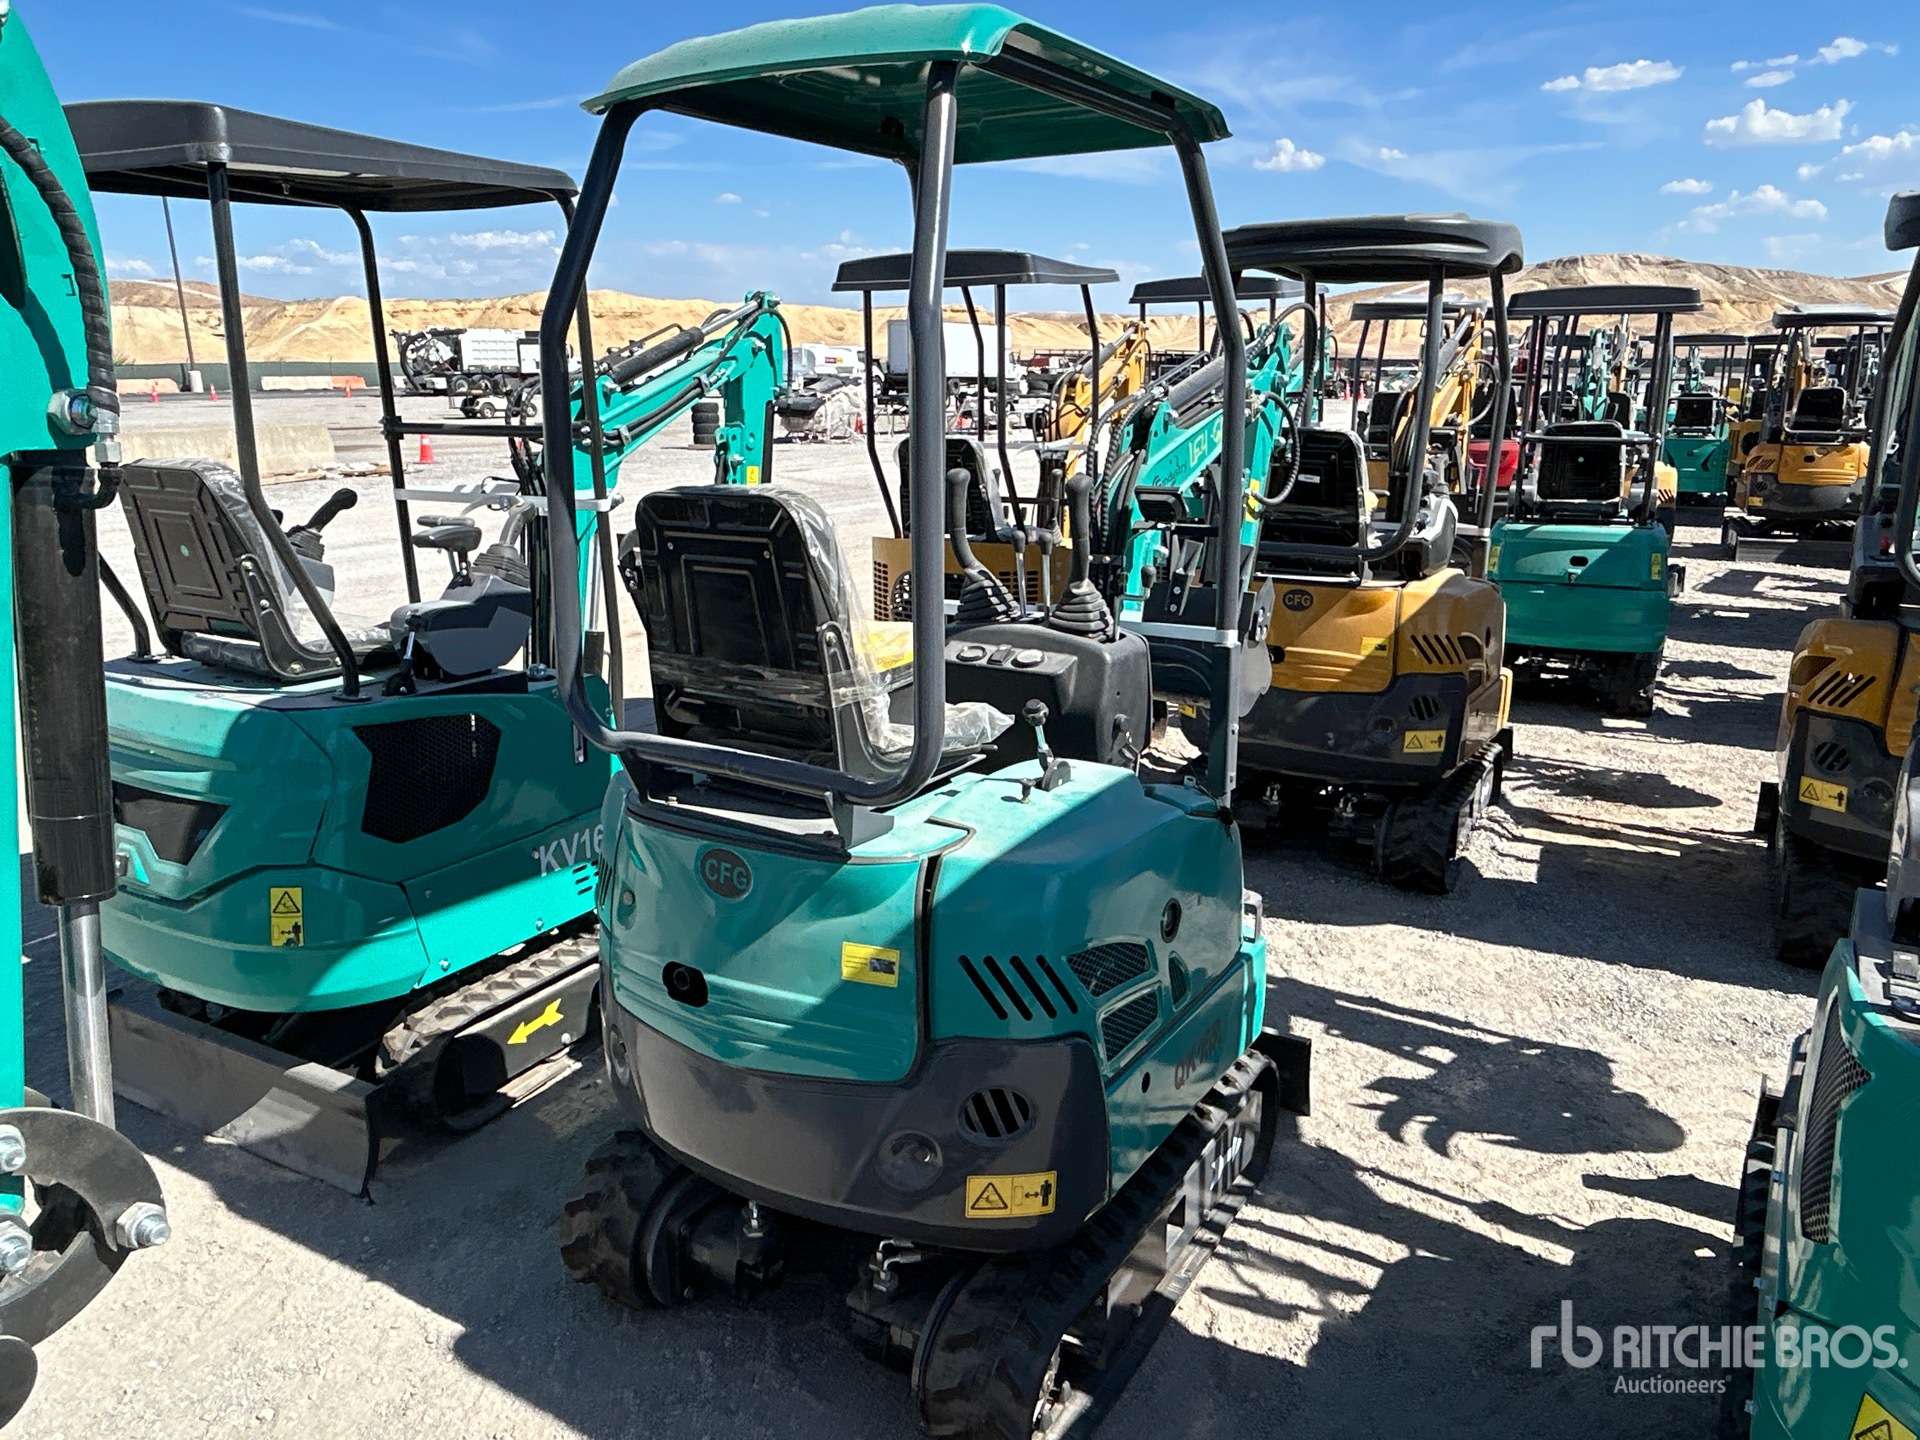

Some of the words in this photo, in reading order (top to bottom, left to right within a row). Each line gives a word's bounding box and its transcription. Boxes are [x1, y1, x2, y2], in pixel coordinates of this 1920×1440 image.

[1285, 594, 1311, 607] CFG
[539, 823, 604, 877] KV16
[704, 857, 748, 890] CFG
